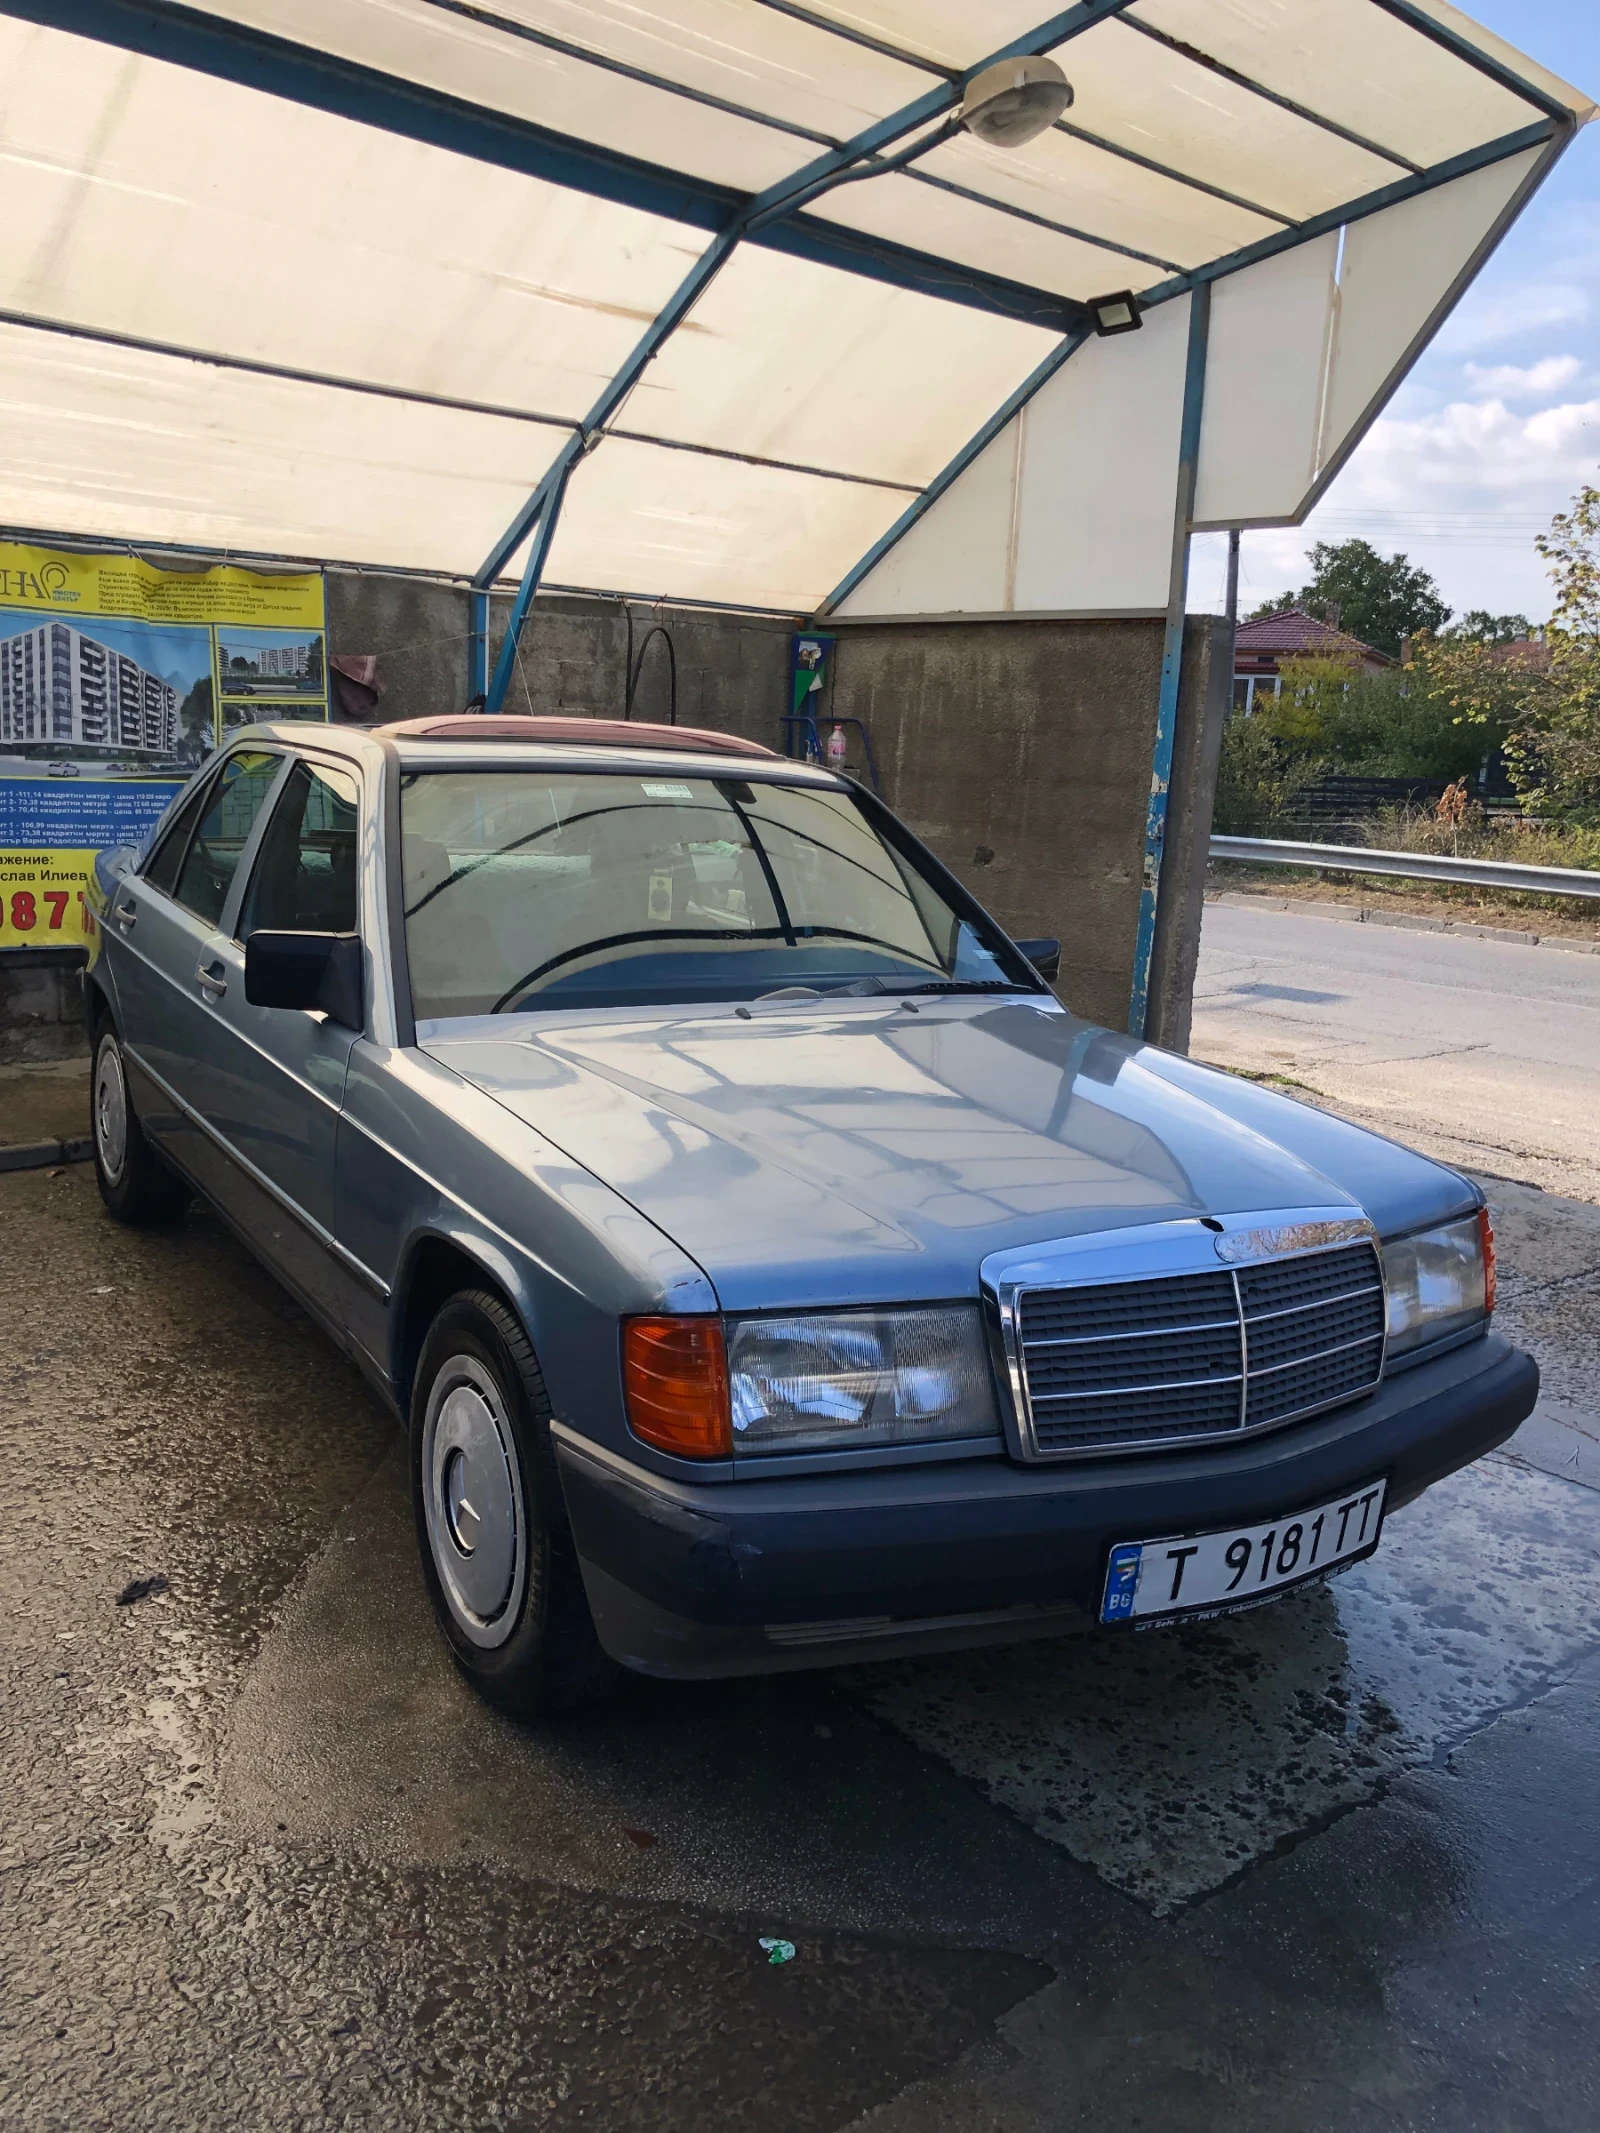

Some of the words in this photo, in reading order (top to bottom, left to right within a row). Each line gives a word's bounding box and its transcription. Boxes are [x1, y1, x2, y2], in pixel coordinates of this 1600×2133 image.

[0, 568, 46, 599] НА
[43, 792, 84, 800] квадратни
[18, 806, 39, 814] 70,43
[82, 808, 107, 816] метра
[20, 829, 41, 837] 73,38
[42, 830, 84, 838] квадратни
[22, 837, 47, 845] Варна
[48, 837, 87, 845] Радослав
[89, 837, 115, 845] Илиев
[40, 869, 88, 881] Илиев
[0, 891, 84, 931] 87
[1166, 1545, 1199, 1602] T
[1224, 1511, 1325, 1592] 9181
[1335, 1487, 1380, 1553] TT
[1108, 1592, 1133, 1611] BG
[1197, 1611, 1220, 1621] PKW
